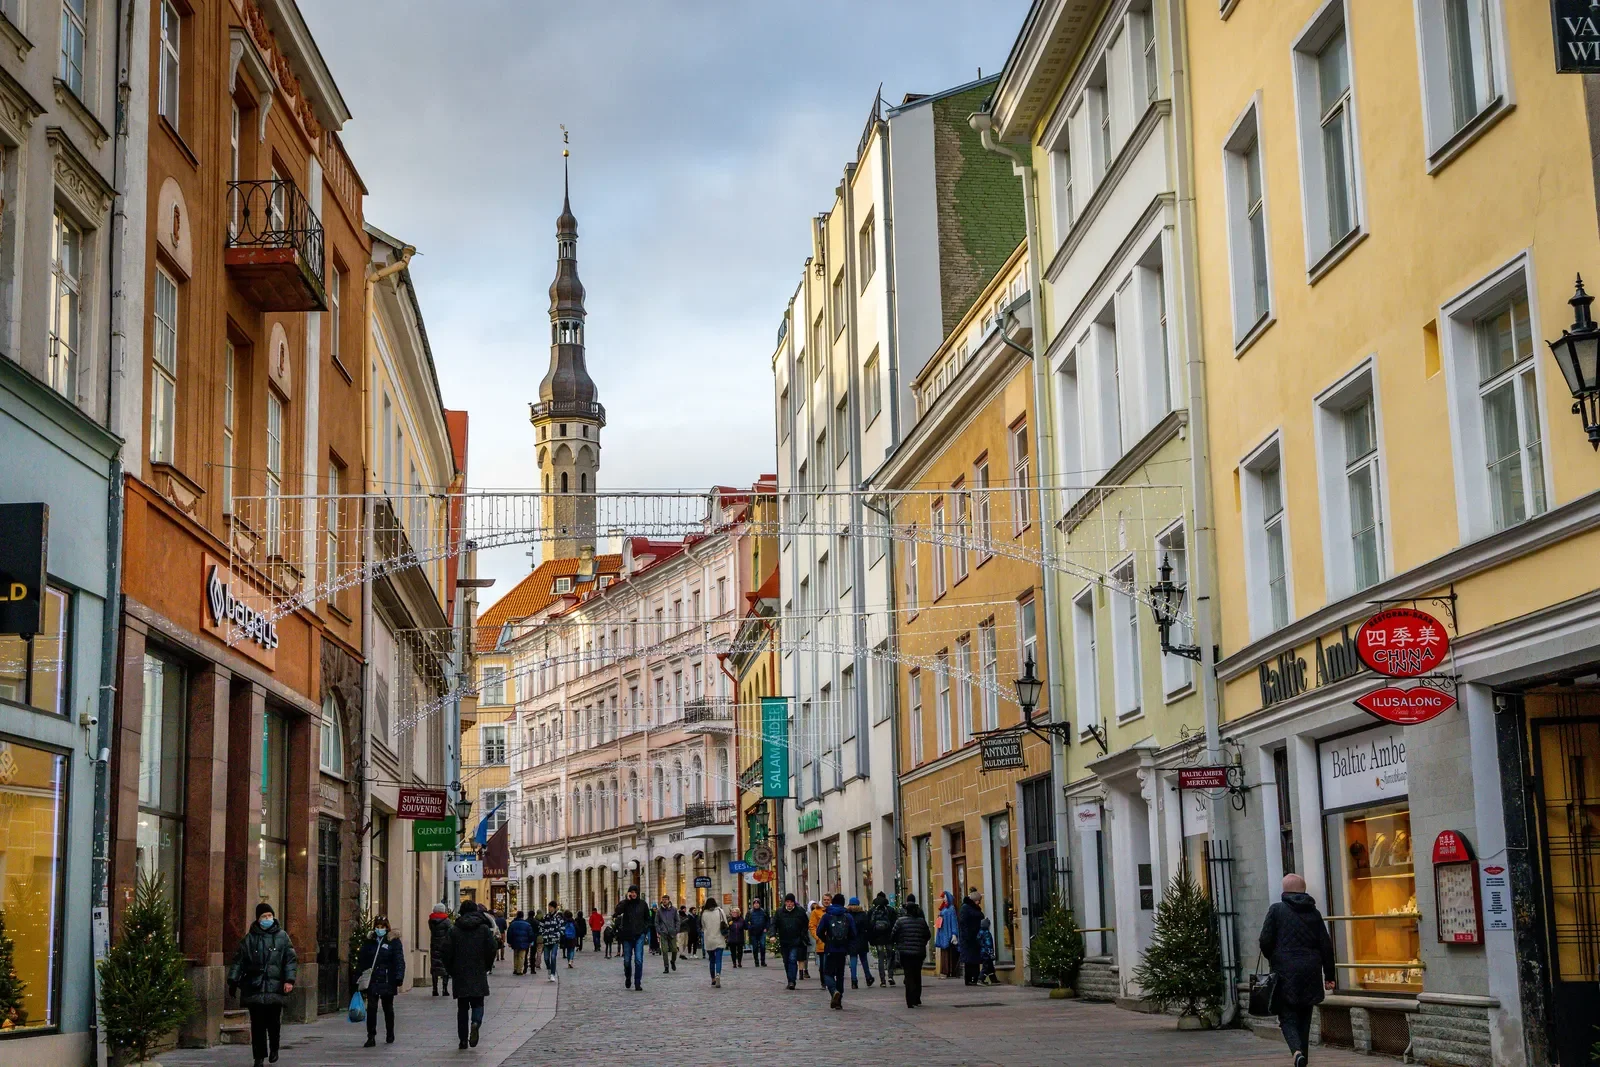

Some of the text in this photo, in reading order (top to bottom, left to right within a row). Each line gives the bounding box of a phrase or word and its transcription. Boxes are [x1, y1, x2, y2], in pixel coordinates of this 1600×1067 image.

[1368, 611, 1434, 627] RESTORAN-BAAR
[1366, 625, 1440, 647] 四季美
[1373, 647, 1435, 662] CHINA
[1258, 624, 1369, 709] Baltic Amb
[1388, 660, 1421, 674] INN
[1372, 697, 1442, 707] ILUSALONG
[768, 706, 782, 789] SALAMANDER
[984, 745, 1019, 758] ANTIQUE
[984, 757, 1023, 768] KULDEHTED
[1331, 744, 1367, 779] Baltic
[401, 804, 442, 814] SOUVENIRS
[417, 826, 452, 836] GLENFIELD
[453, 864, 478, 873] CRU
